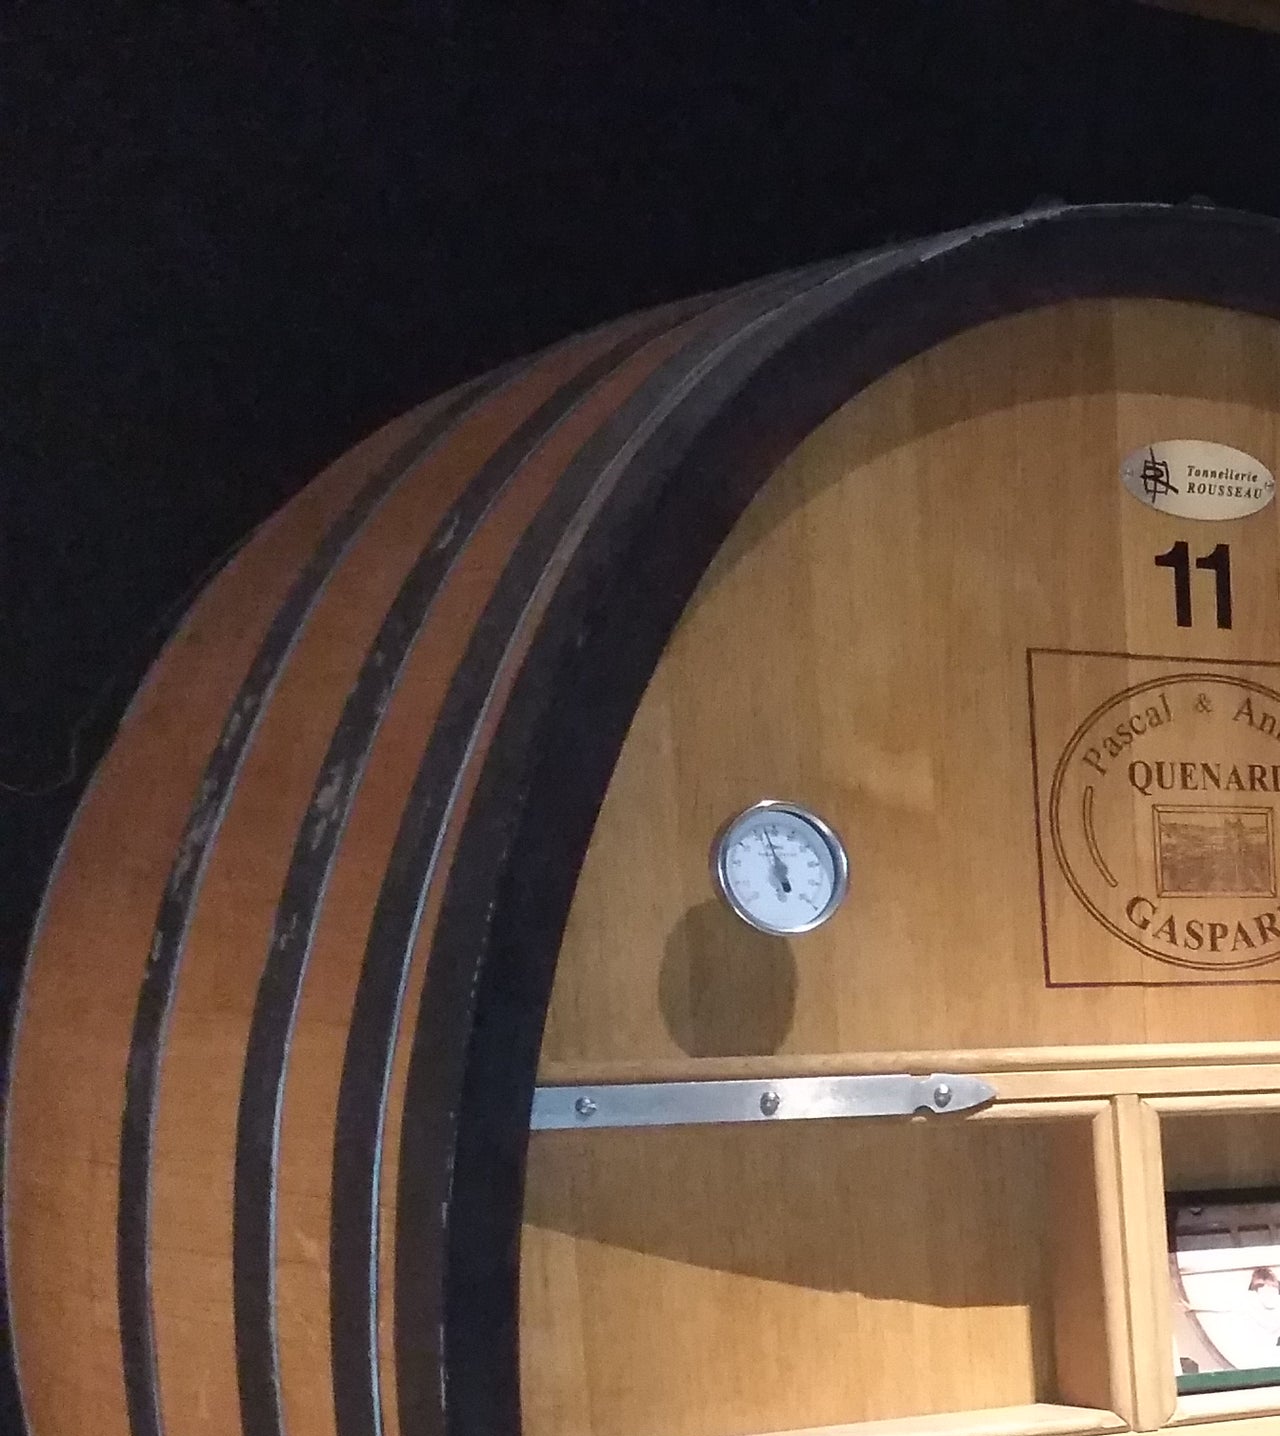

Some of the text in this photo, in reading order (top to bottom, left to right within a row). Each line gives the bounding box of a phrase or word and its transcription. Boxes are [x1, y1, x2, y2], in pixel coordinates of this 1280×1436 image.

[1187, 465, 1258, 483] Tonnellerie
[1187, 481, 1263, 500] ROUSSEAU
[1155, 541, 1233, 629] 11
[1083, 692, 1172, 776] Pascal
[1195, 692, 1213, 714] &
